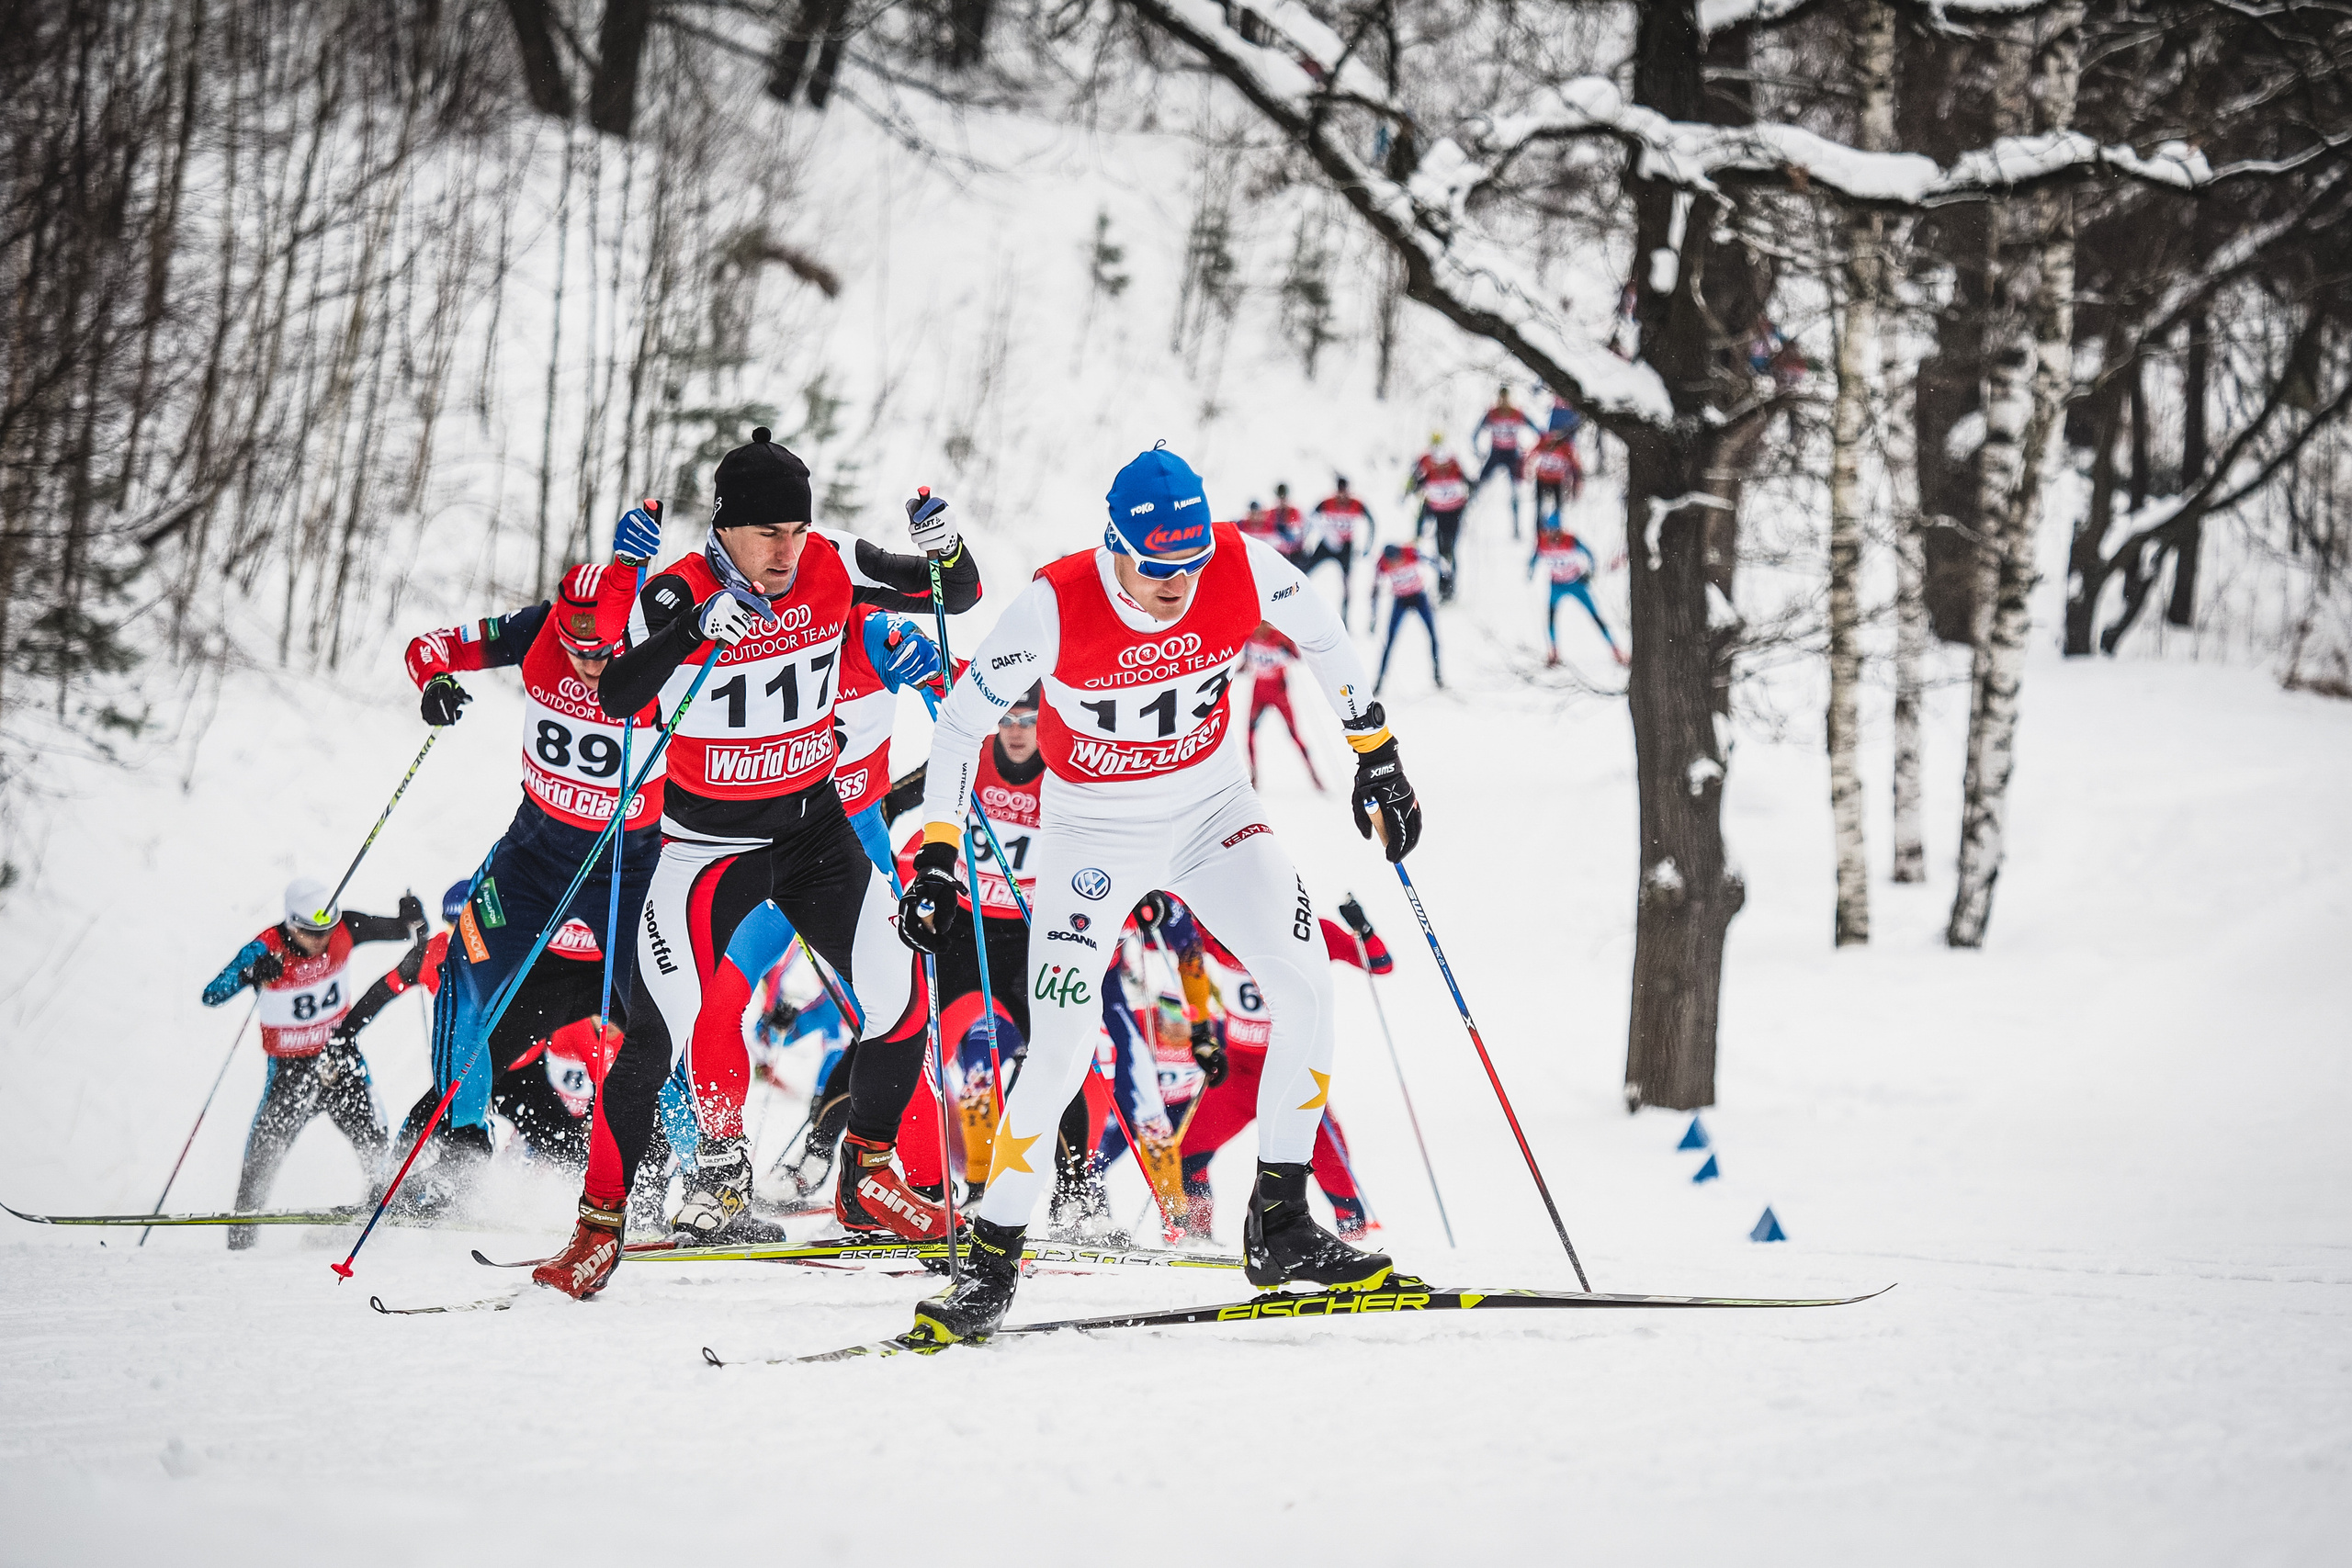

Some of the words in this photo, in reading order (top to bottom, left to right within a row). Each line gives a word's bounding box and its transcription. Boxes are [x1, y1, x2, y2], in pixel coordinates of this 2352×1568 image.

[1130, 502, 1155, 516] TOKO
[1155, 524, 1204, 544] KANT
[718, 634, 799, 663] OUTDOOR
[802, 621, 840, 644] TEAM
[991, 652, 1023, 670] CRAFT
[711, 645, 839, 728] 117
[1084, 662, 1180, 688] OUTDOOR
[1185, 646, 1234, 671] TEAM
[532, 685, 596, 720] OUTDOOR
[836, 687, 858, 701] AM
[1080, 665, 1231, 738] 113
[537, 719, 623, 778] 89
[711, 746, 786, 781] World
[786, 728, 833, 772] Class
[957, 762, 967, 807] VATTENFALL
[1370, 763, 1395, 779] SWIX
[971, 825, 1031, 871] 91
[1224, 825, 1261, 846] TEAM
[930, 868, 956, 883] SWIX
[1405, 885, 1434, 937] SWIX
[644, 899, 679, 976] sportful
[1046, 931, 1098, 952] SCANIA
[294, 981, 341, 1021] 84
[1035, 963, 1091, 1009] life
[591, 1213, 618, 1223] alpina
[571, 1237, 619, 1290] alpin
[839, 1248, 922, 1259] FISCHER
[1217, 1292, 1430, 1322] FISCHER
